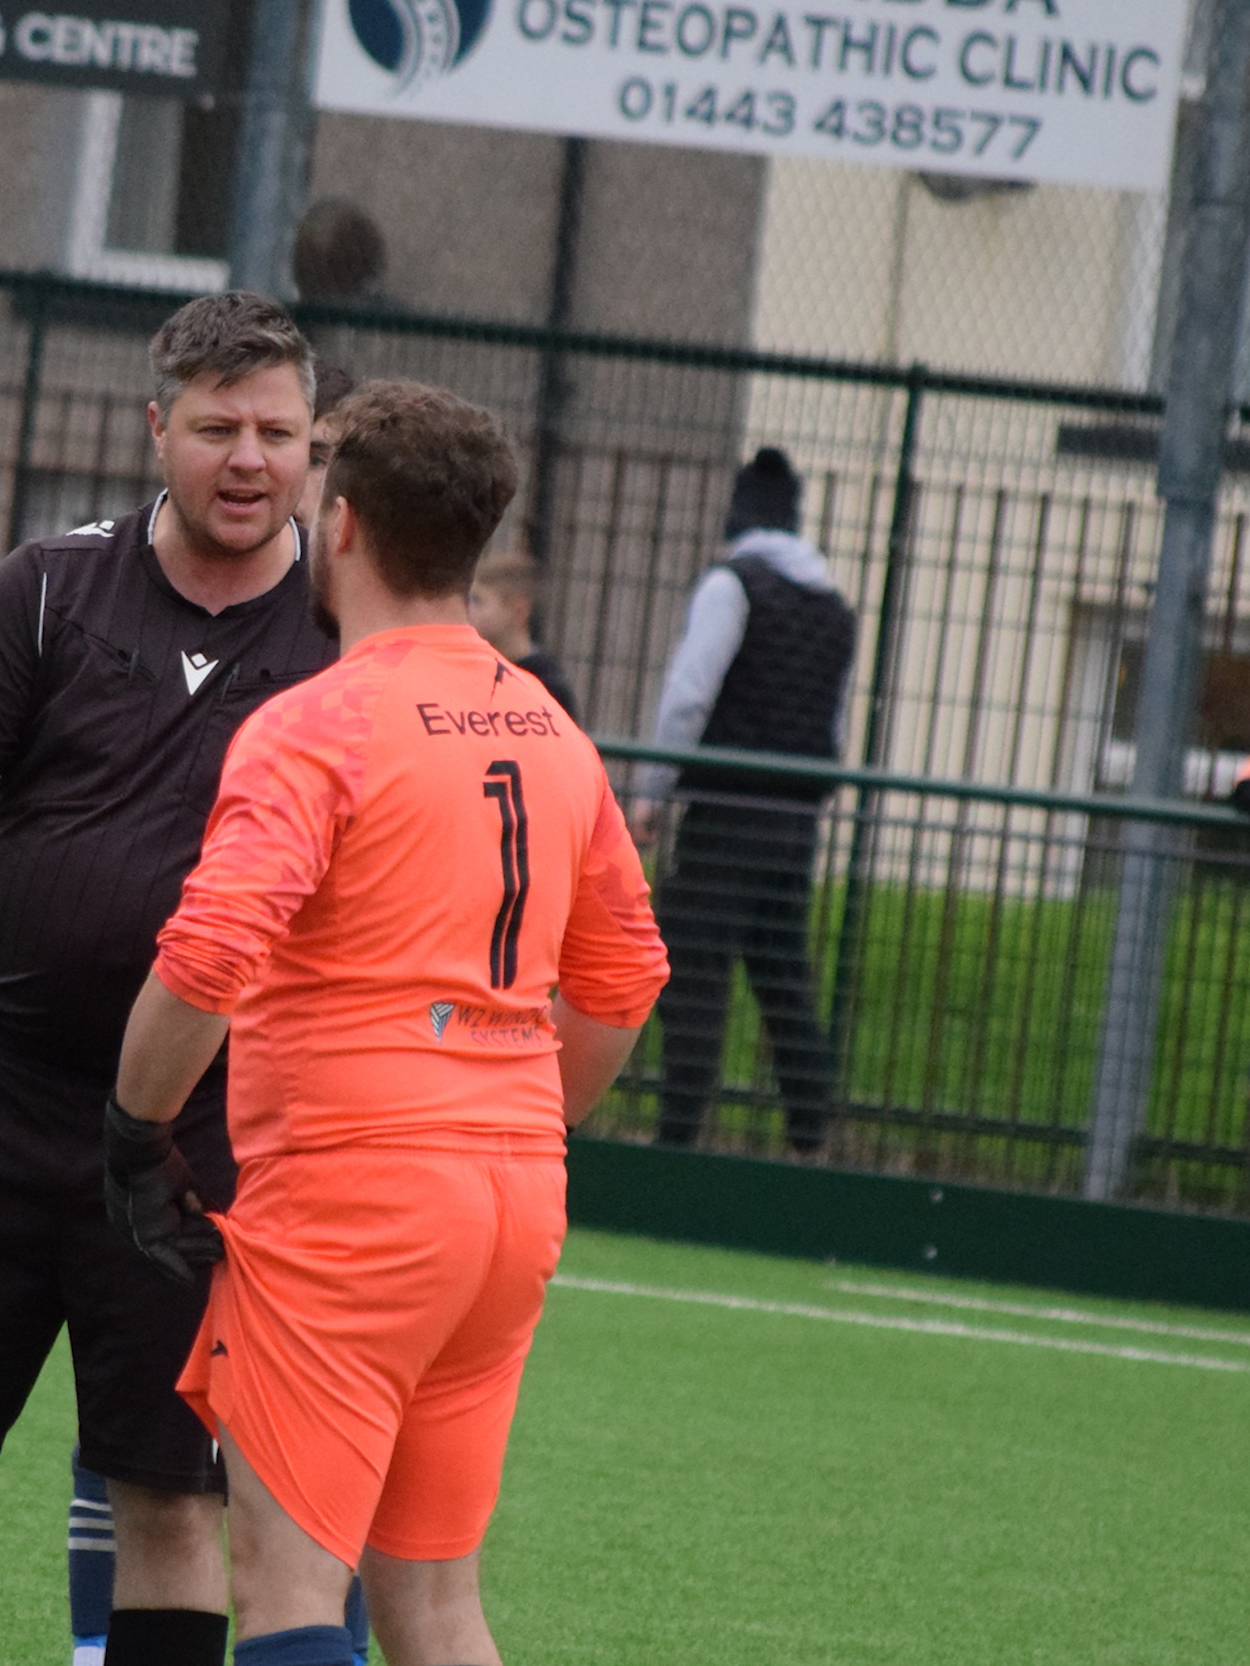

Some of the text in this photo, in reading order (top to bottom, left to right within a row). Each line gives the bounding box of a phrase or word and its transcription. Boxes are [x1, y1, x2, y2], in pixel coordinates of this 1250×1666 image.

[15, 11, 200, 78] CENTRE
[517, 0, 1162, 103] OSTEOPATHIC CLINIC
[617, 75, 1042, 160] 01443 438577
[416, 702, 561, 737] Everest
[483, 760, 530, 989] 1
